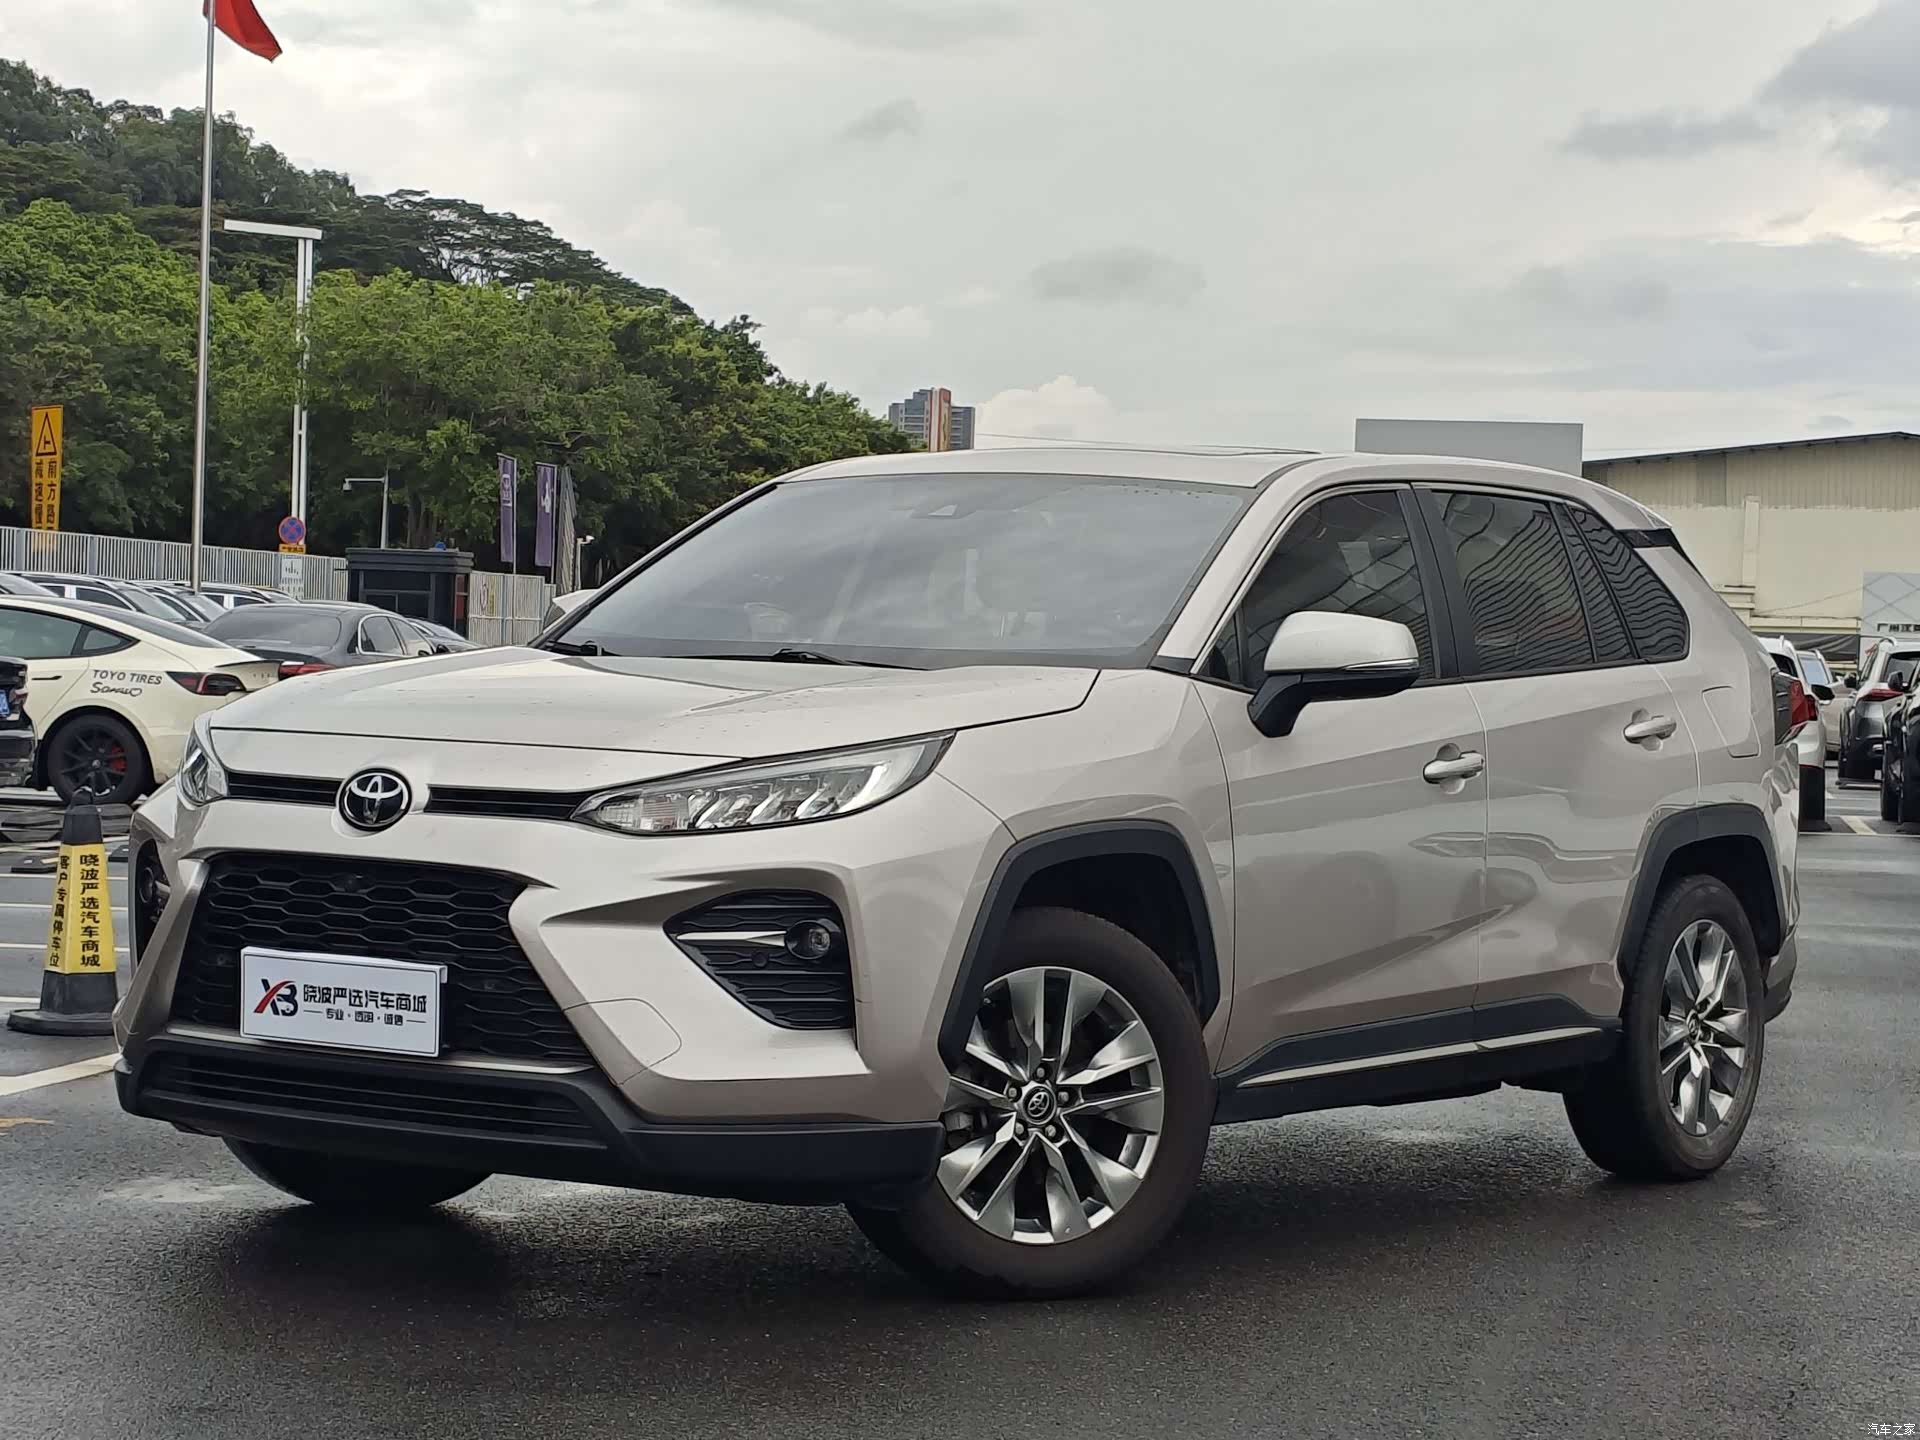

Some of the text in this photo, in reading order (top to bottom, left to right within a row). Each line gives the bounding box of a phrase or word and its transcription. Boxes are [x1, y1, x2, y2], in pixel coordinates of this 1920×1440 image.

[46, 459, 57, 530] 前方路
[93, 669, 163, 685] TOYO TIRES
[49, 855, 70, 967] 客户专属停车位
[79, 854, 101, 967] 晓波严选汽车商城
[303, 984, 427, 1013] 晓波严选汽车商城
